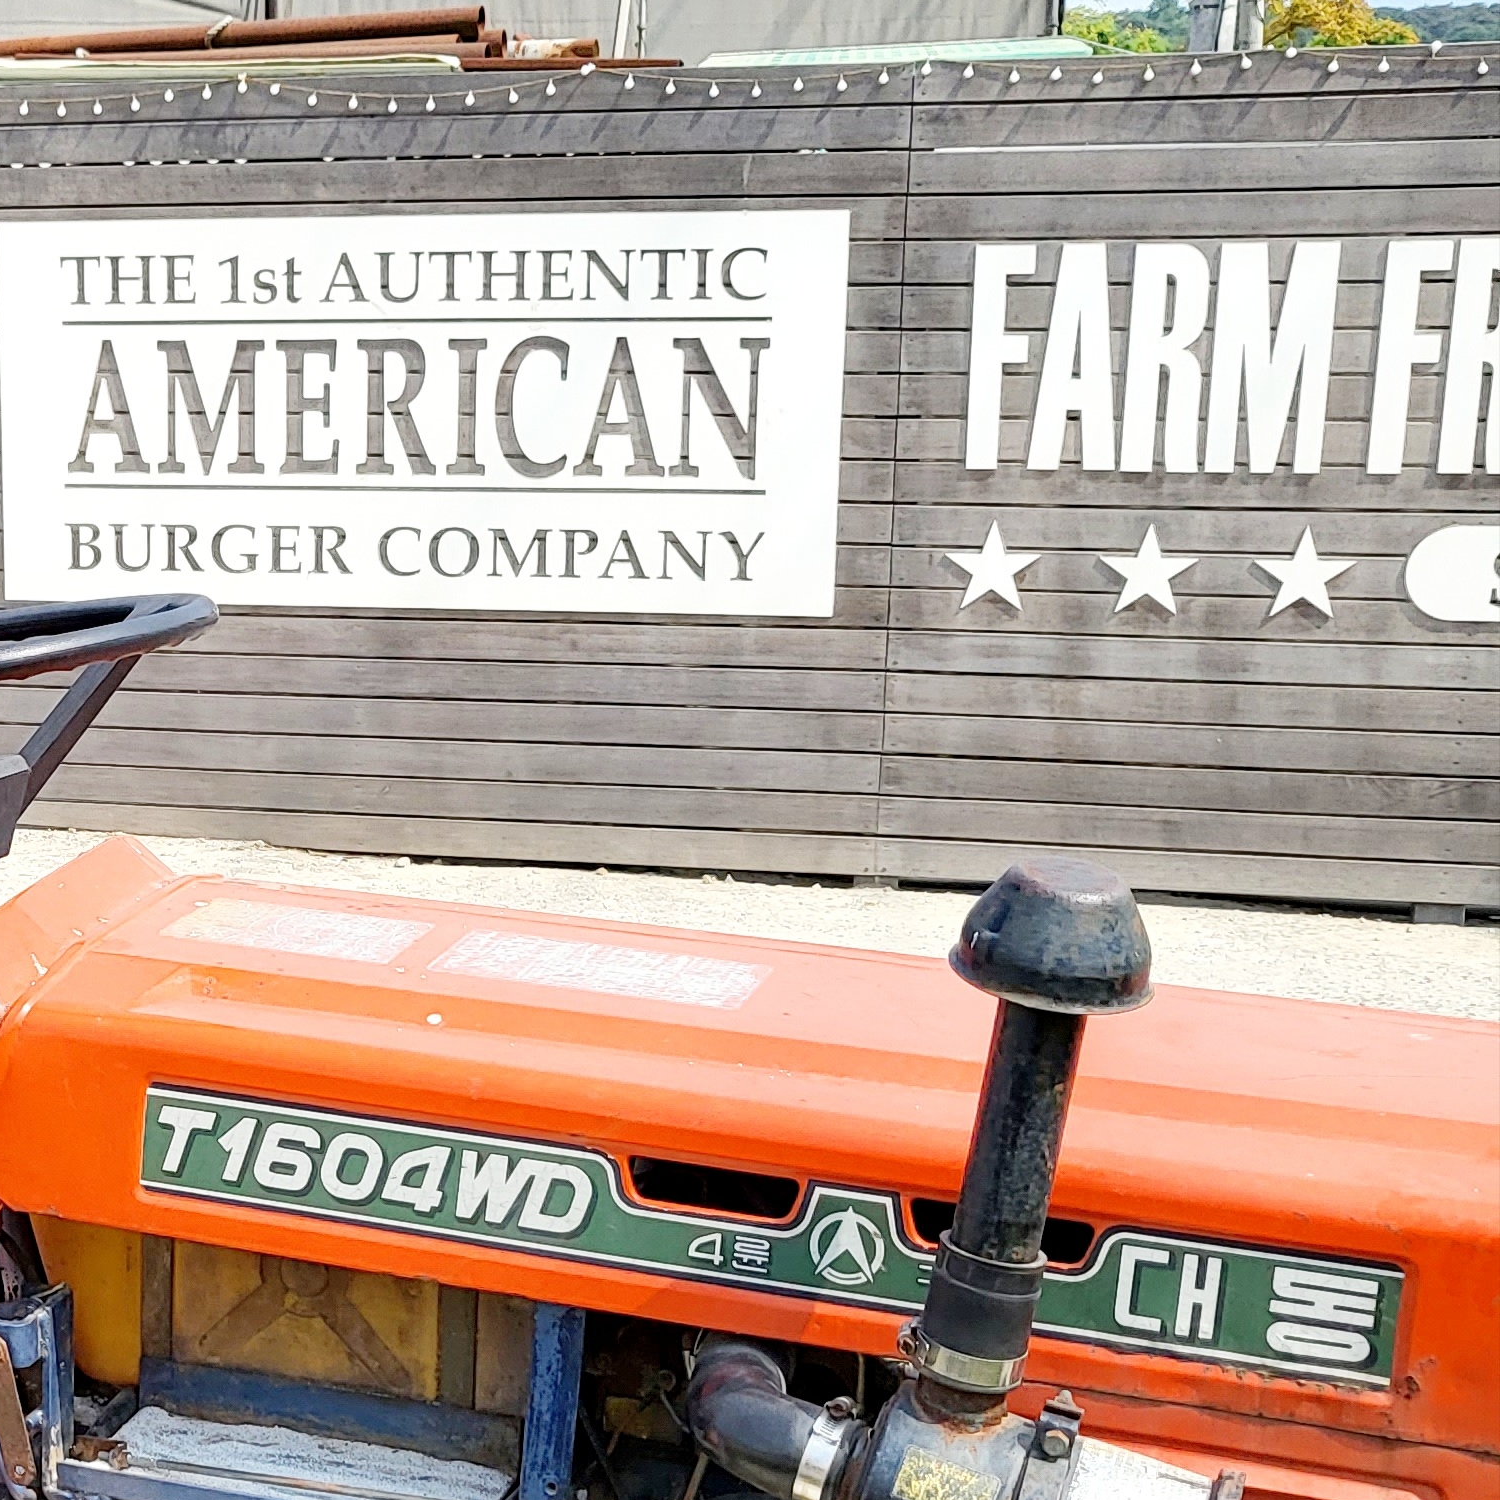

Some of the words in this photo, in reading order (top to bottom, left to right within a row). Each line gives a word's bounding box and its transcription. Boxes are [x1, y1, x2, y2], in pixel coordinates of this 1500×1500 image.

[60, 254, 196, 307] THE
[218, 254, 302, 306] 1st
[319, 246, 770, 304] AUTHENTIC
[67, 335, 771, 482] AMERICAN
[965, 239, 1343, 475] FARM
[64, 522, 354, 577] BURGER
[377, 525, 767, 583] COMPANY
